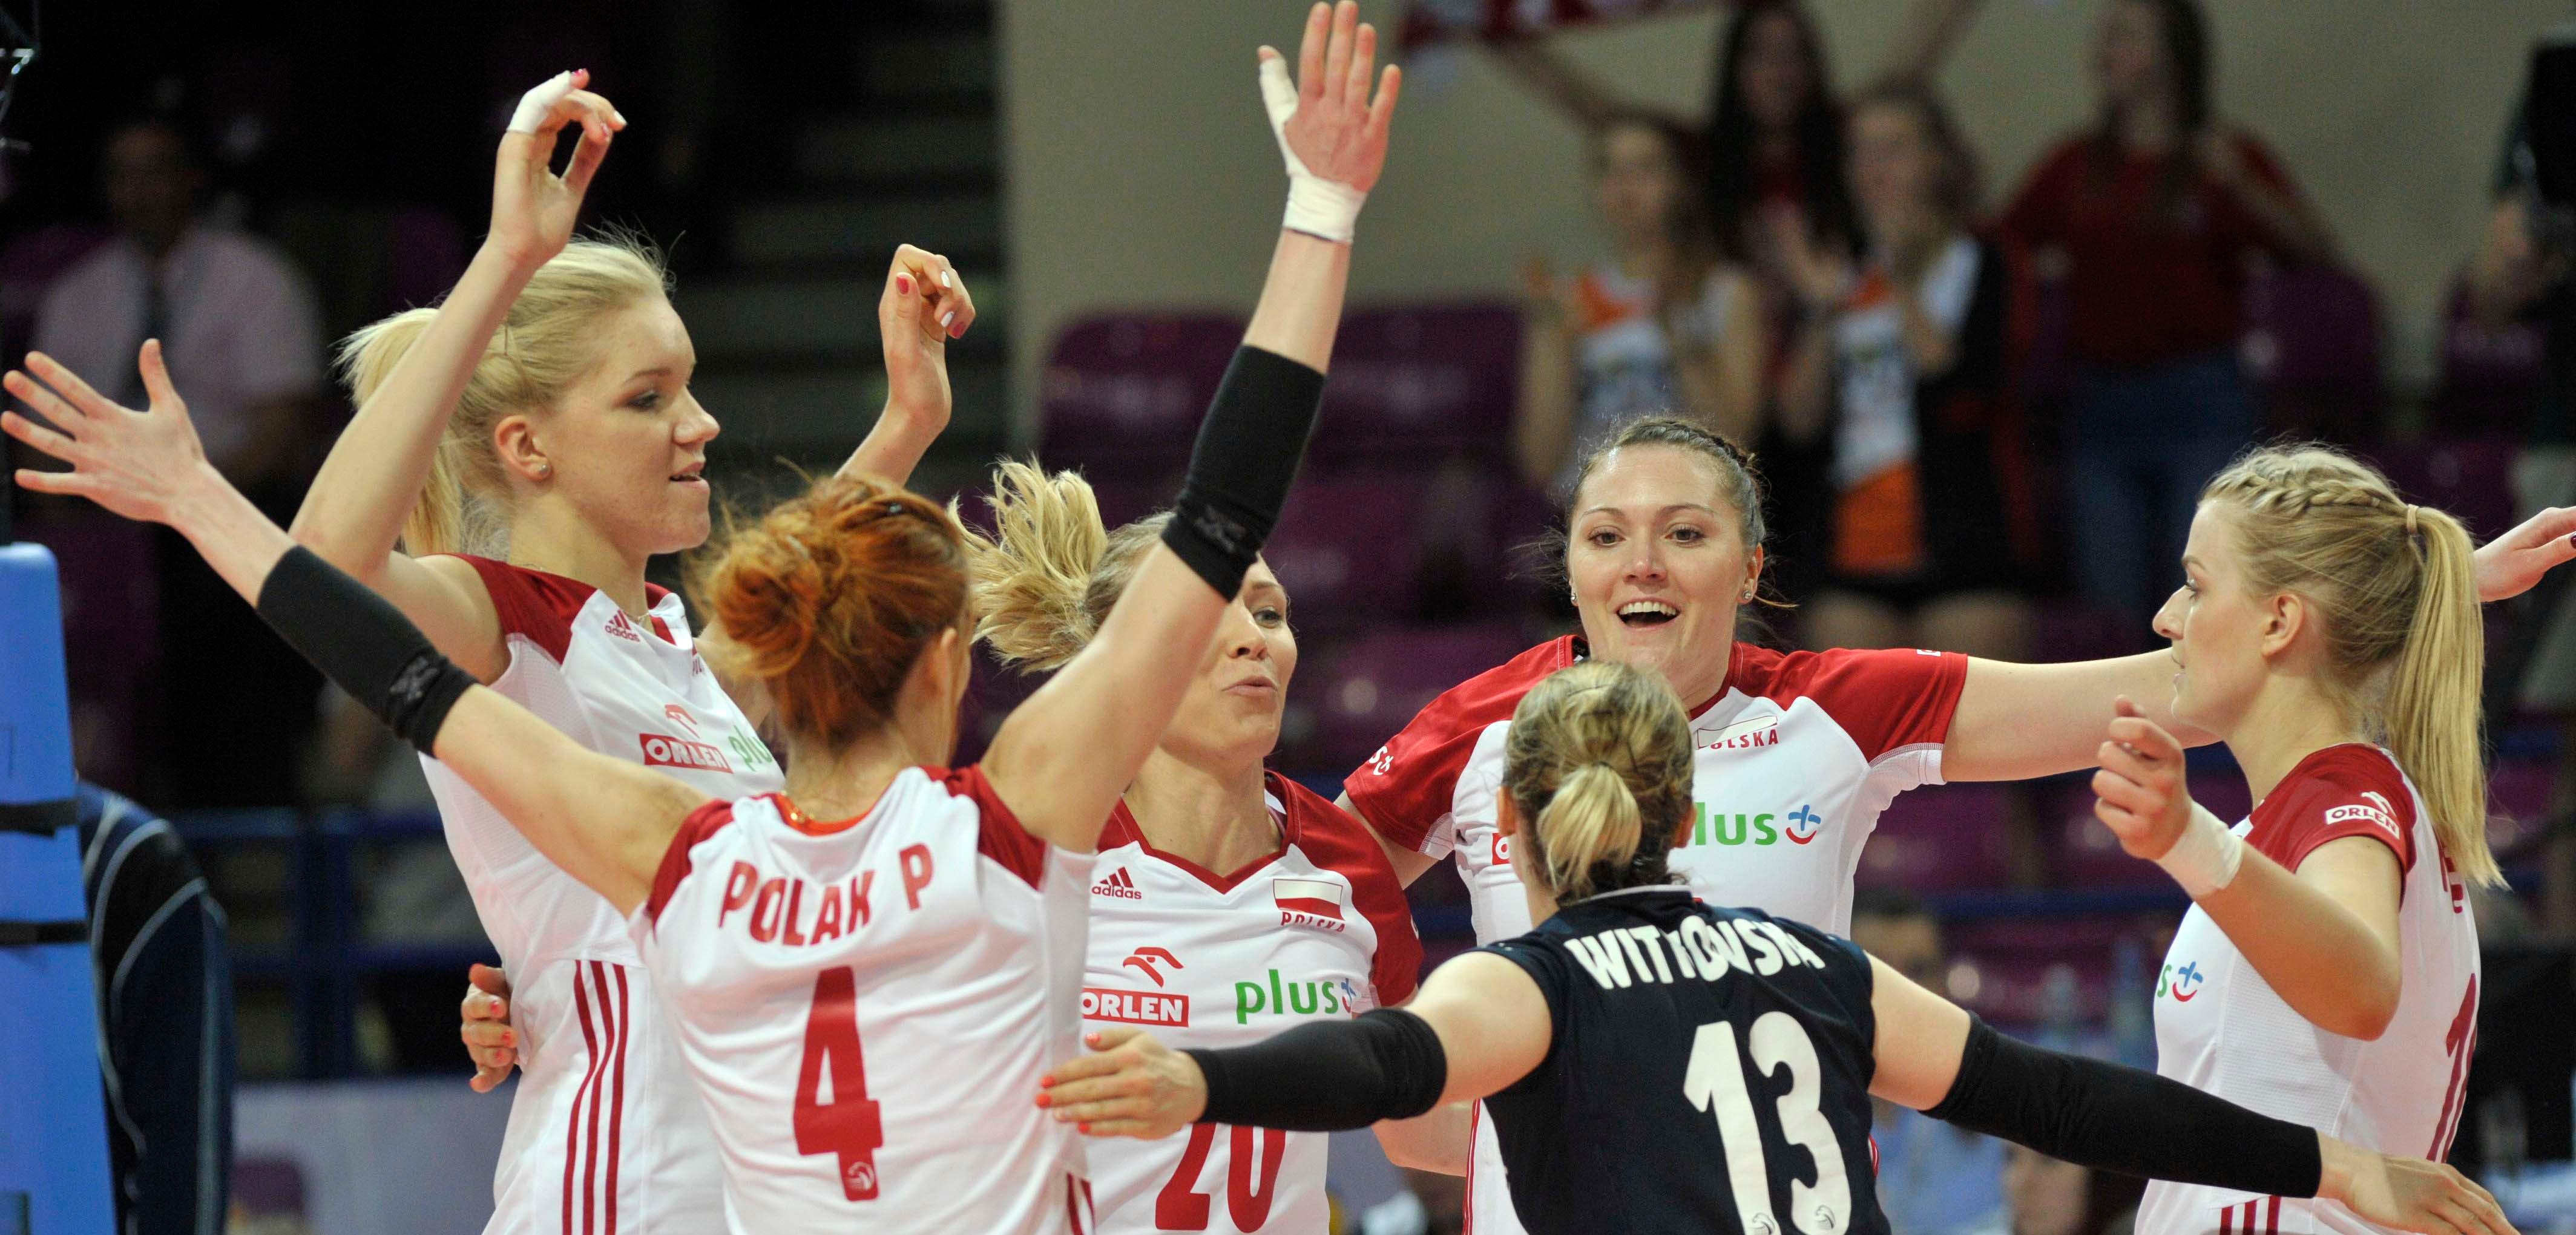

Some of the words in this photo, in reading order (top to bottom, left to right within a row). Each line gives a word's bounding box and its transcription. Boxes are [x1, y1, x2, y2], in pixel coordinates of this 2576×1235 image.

[604, 624, 642, 643] adidas
[646, 738, 730, 769] ORLEN
[728, 724, 774, 772] plu
[1710, 729, 1779, 750] OLSKA
[1695, 802, 1778, 846] lus
[2331, 807, 2396, 833] ORLEN
[718, 860, 875, 946] POLAK
[899, 844, 933, 911] P
[1091, 885, 1142, 900] adidas
[1080, 991, 1183, 1023] ORLEN
[1235, 969, 1339, 1024] plus
[793, 965, 884, 1201] 4
[2425, 972, 2478, 1164] 1
[1683, 1011, 1852, 1235] 13
[1155, 1121, 1287, 1234] 20
